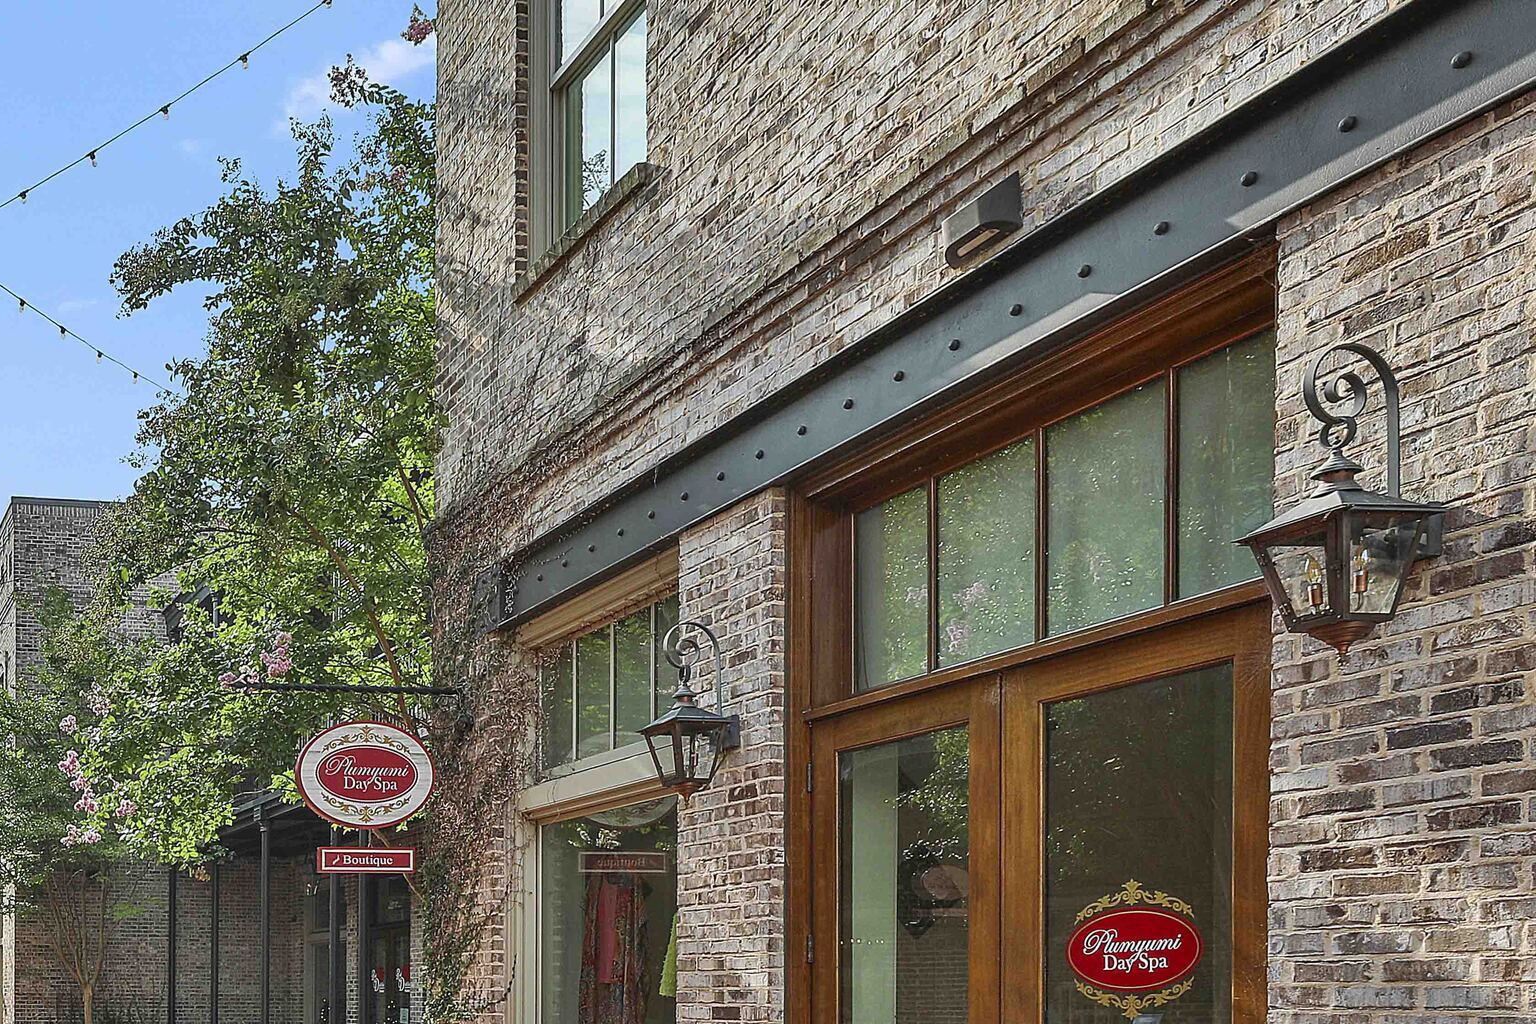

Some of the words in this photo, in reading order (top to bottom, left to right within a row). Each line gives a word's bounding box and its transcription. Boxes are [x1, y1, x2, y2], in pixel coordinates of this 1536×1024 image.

[325, 755, 409, 784] Plumyumi
[344, 776, 369, 792] Day
[373, 776, 398, 793] Spa
[342, 855, 393, 867] Boutique
[1083, 929, 1182, 961] Plumyumi
[1103, 954, 1134, 973] Day
[1138, 952, 1168, 972] Spa
